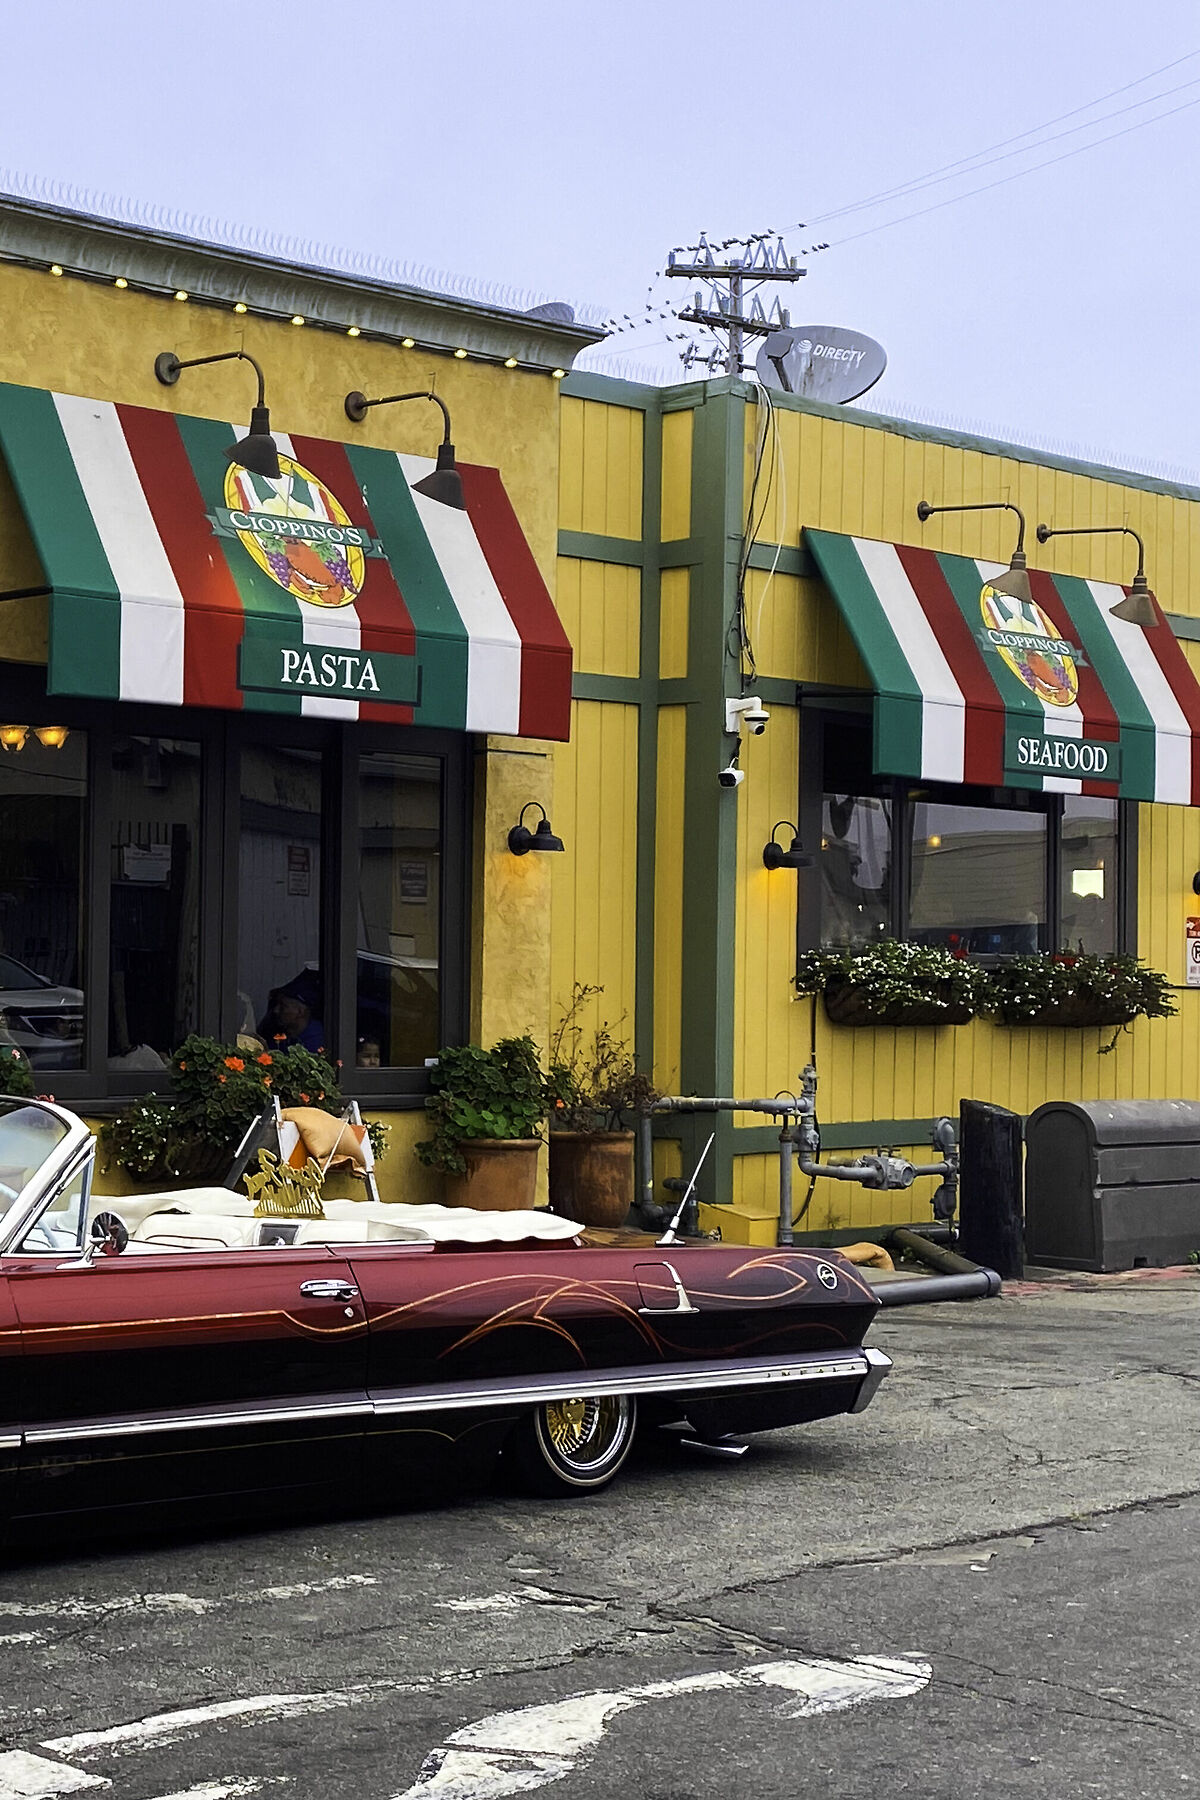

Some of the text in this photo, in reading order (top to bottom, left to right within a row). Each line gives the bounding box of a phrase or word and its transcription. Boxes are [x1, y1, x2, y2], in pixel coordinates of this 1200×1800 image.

[229, 511, 363, 545] CIOPPINO'S
[987, 629, 1070, 655] CIOPPINO'S
[280, 649, 381, 692] PASTA
[1017, 737, 1108, 772] SEAFOOD
